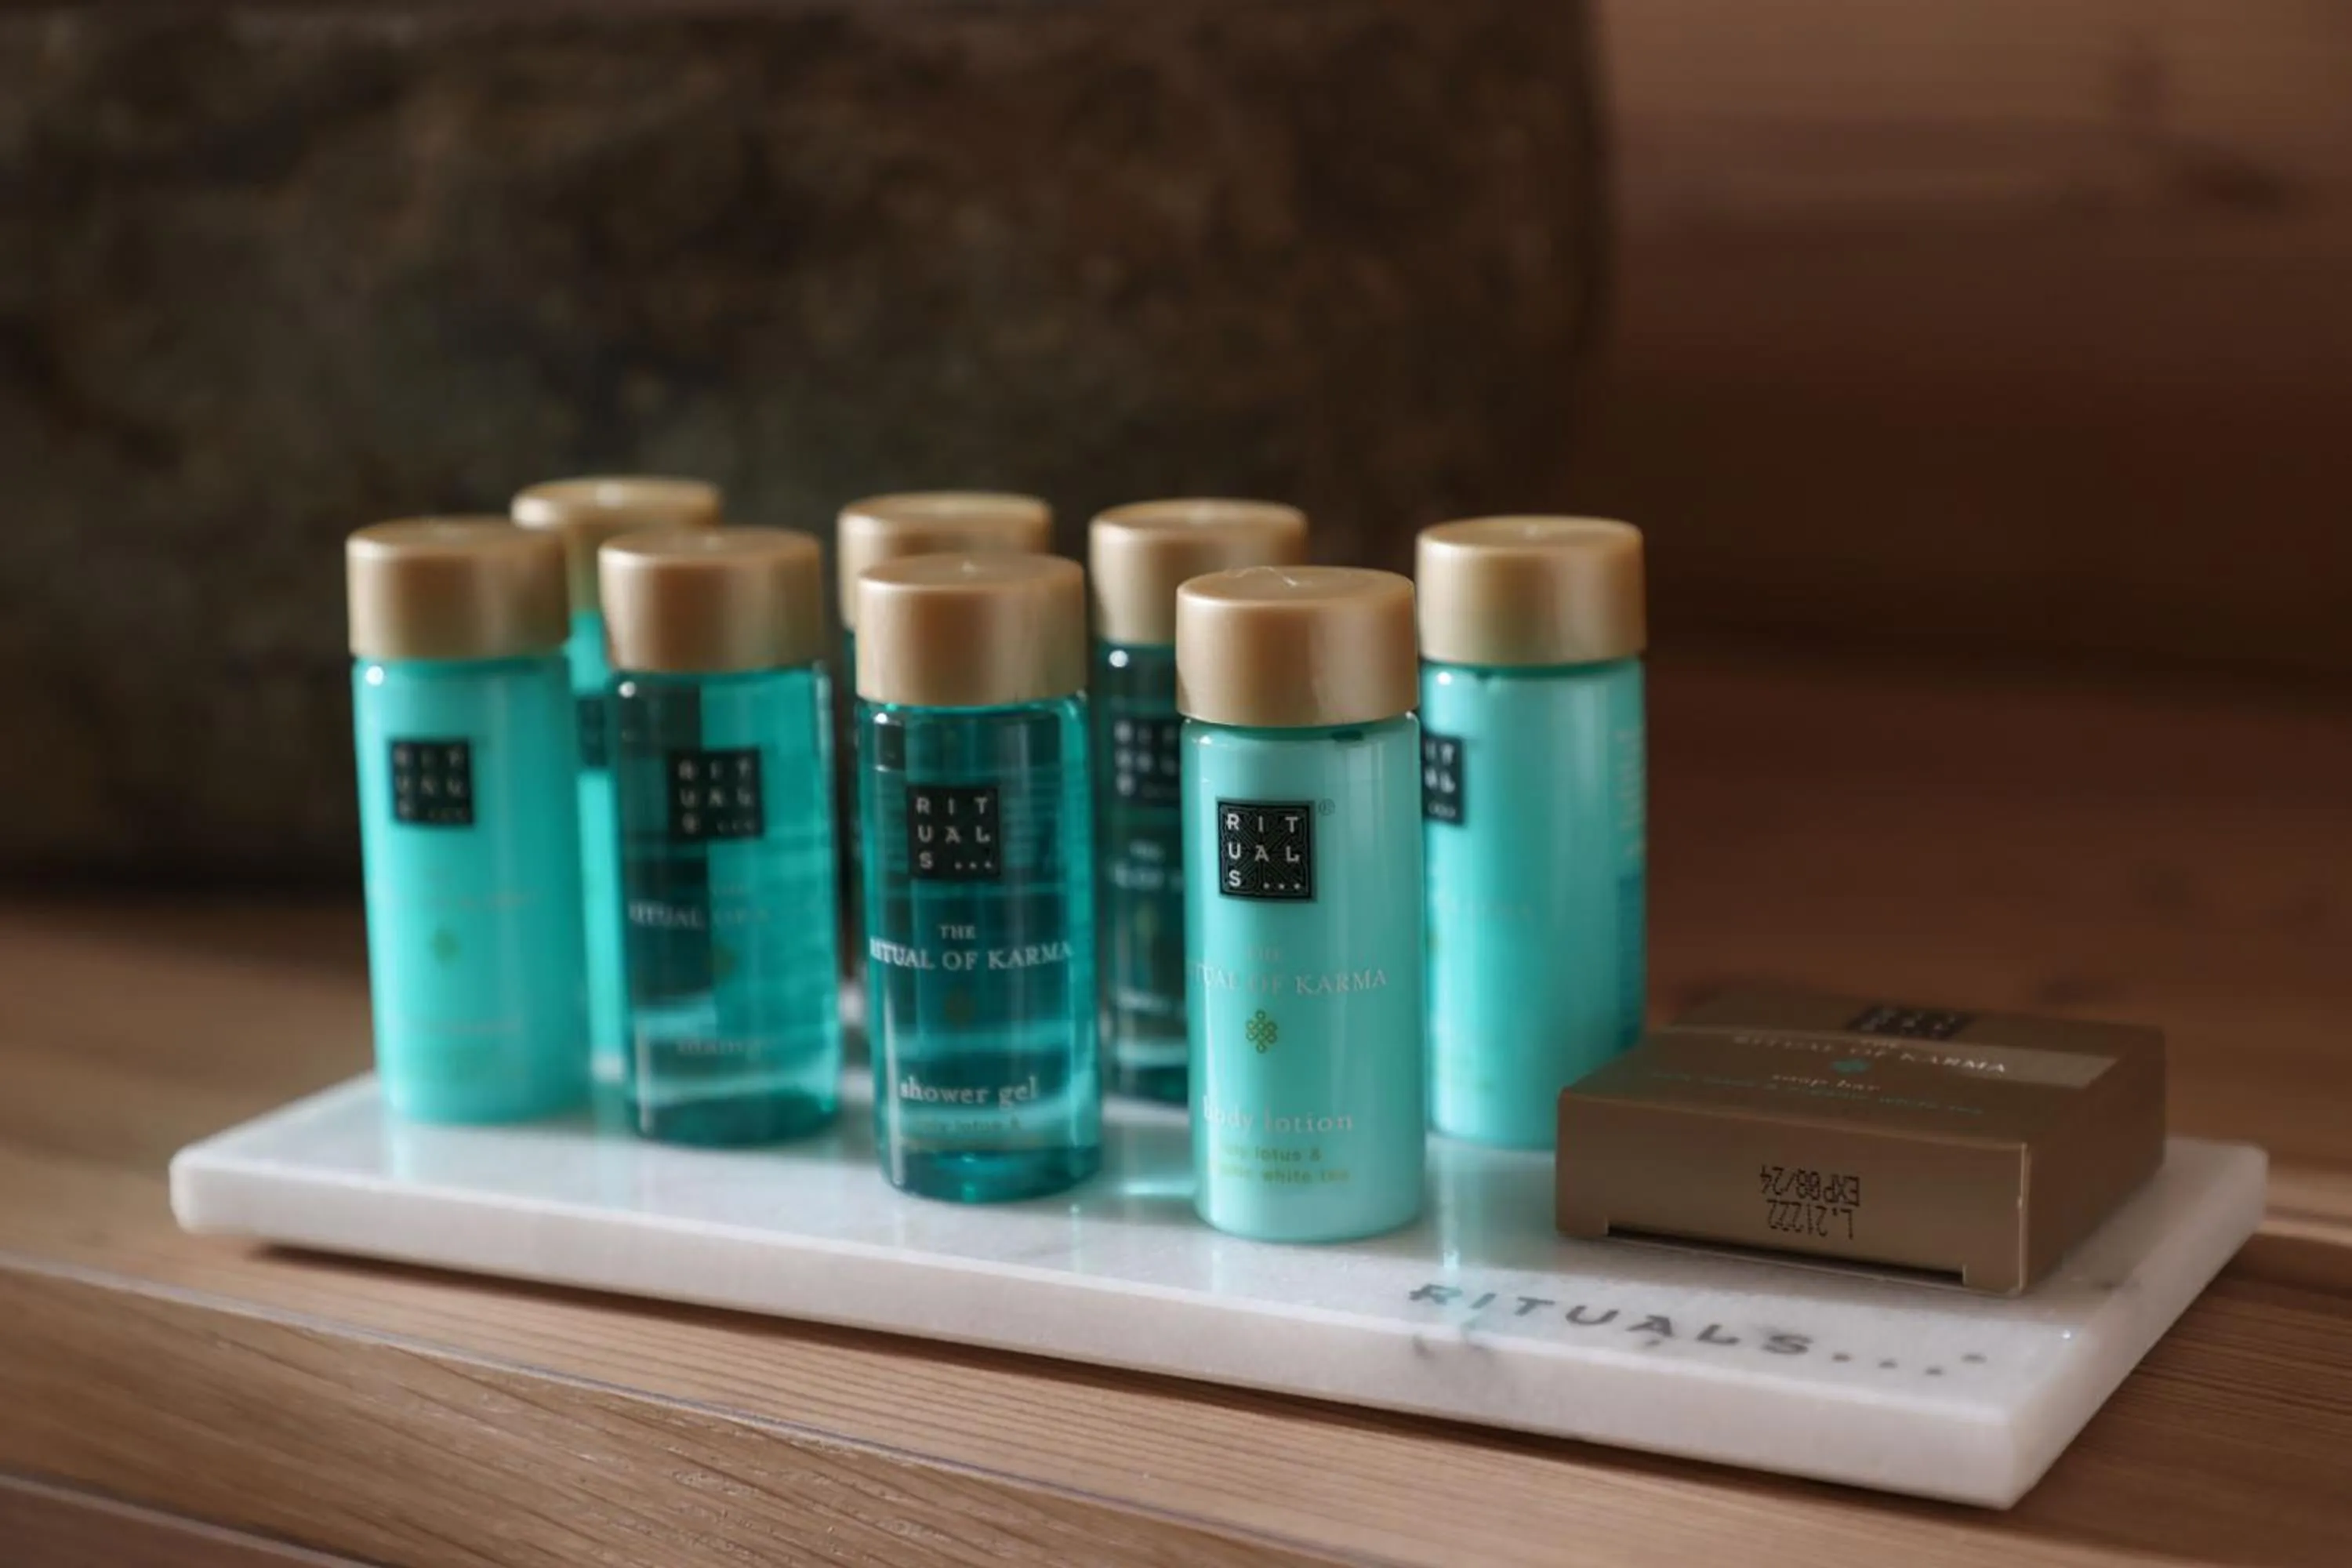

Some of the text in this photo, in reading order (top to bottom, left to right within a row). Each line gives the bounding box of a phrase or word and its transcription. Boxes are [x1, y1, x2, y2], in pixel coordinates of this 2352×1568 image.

[940, 924, 977, 940] THE
[942, 949, 978, 971] OF
[987, 941, 1076, 970] KARMA
[1295, 967, 1388, 996] KARMA
[899, 1075, 1040, 1113] shower gel
[1264, 1103, 1354, 1134] lotion
